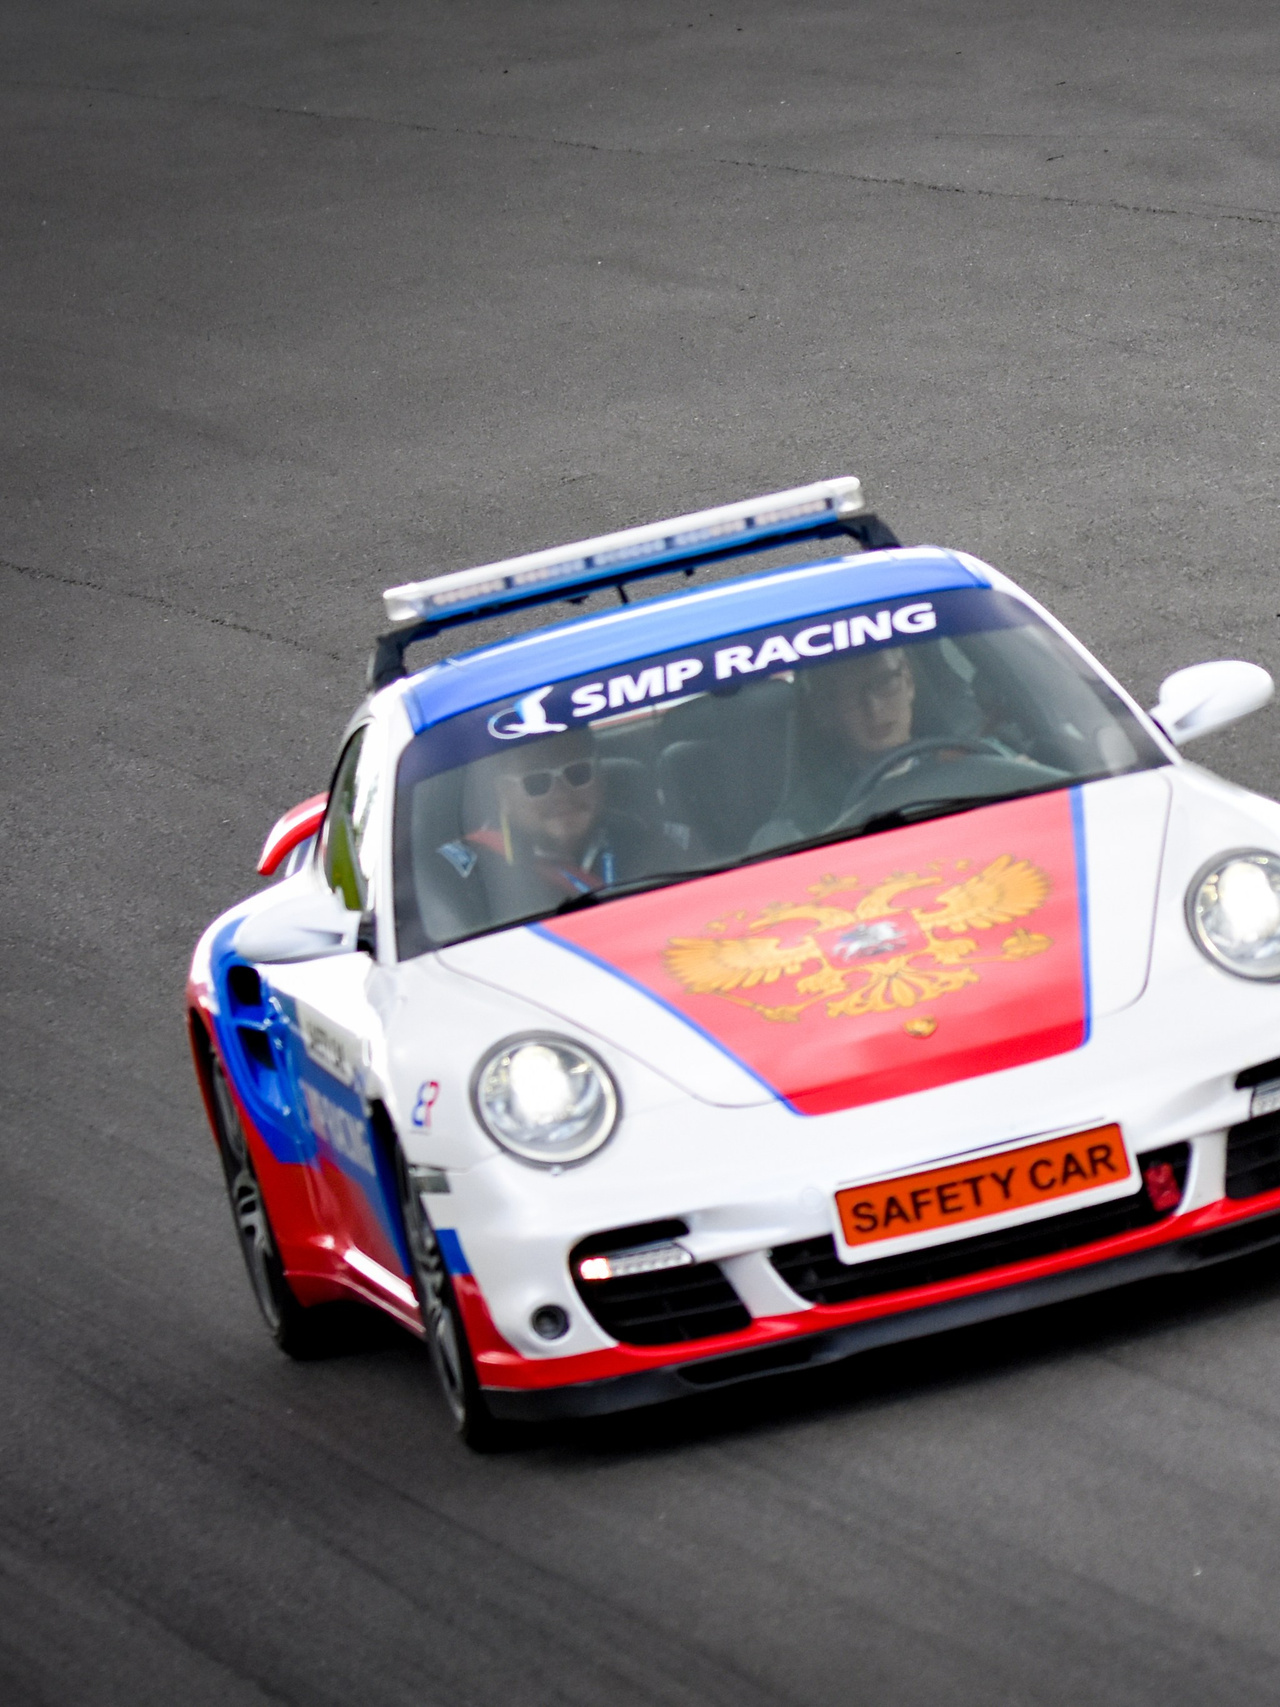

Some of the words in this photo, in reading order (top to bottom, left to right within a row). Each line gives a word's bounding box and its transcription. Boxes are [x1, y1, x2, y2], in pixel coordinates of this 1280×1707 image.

[571, 657, 704, 718] SMP
[714, 602, 938, 680] RACING
[852, 1166, 1017, 1234] SAFETY
[1028, 1143, 1118, 1192] CAR
